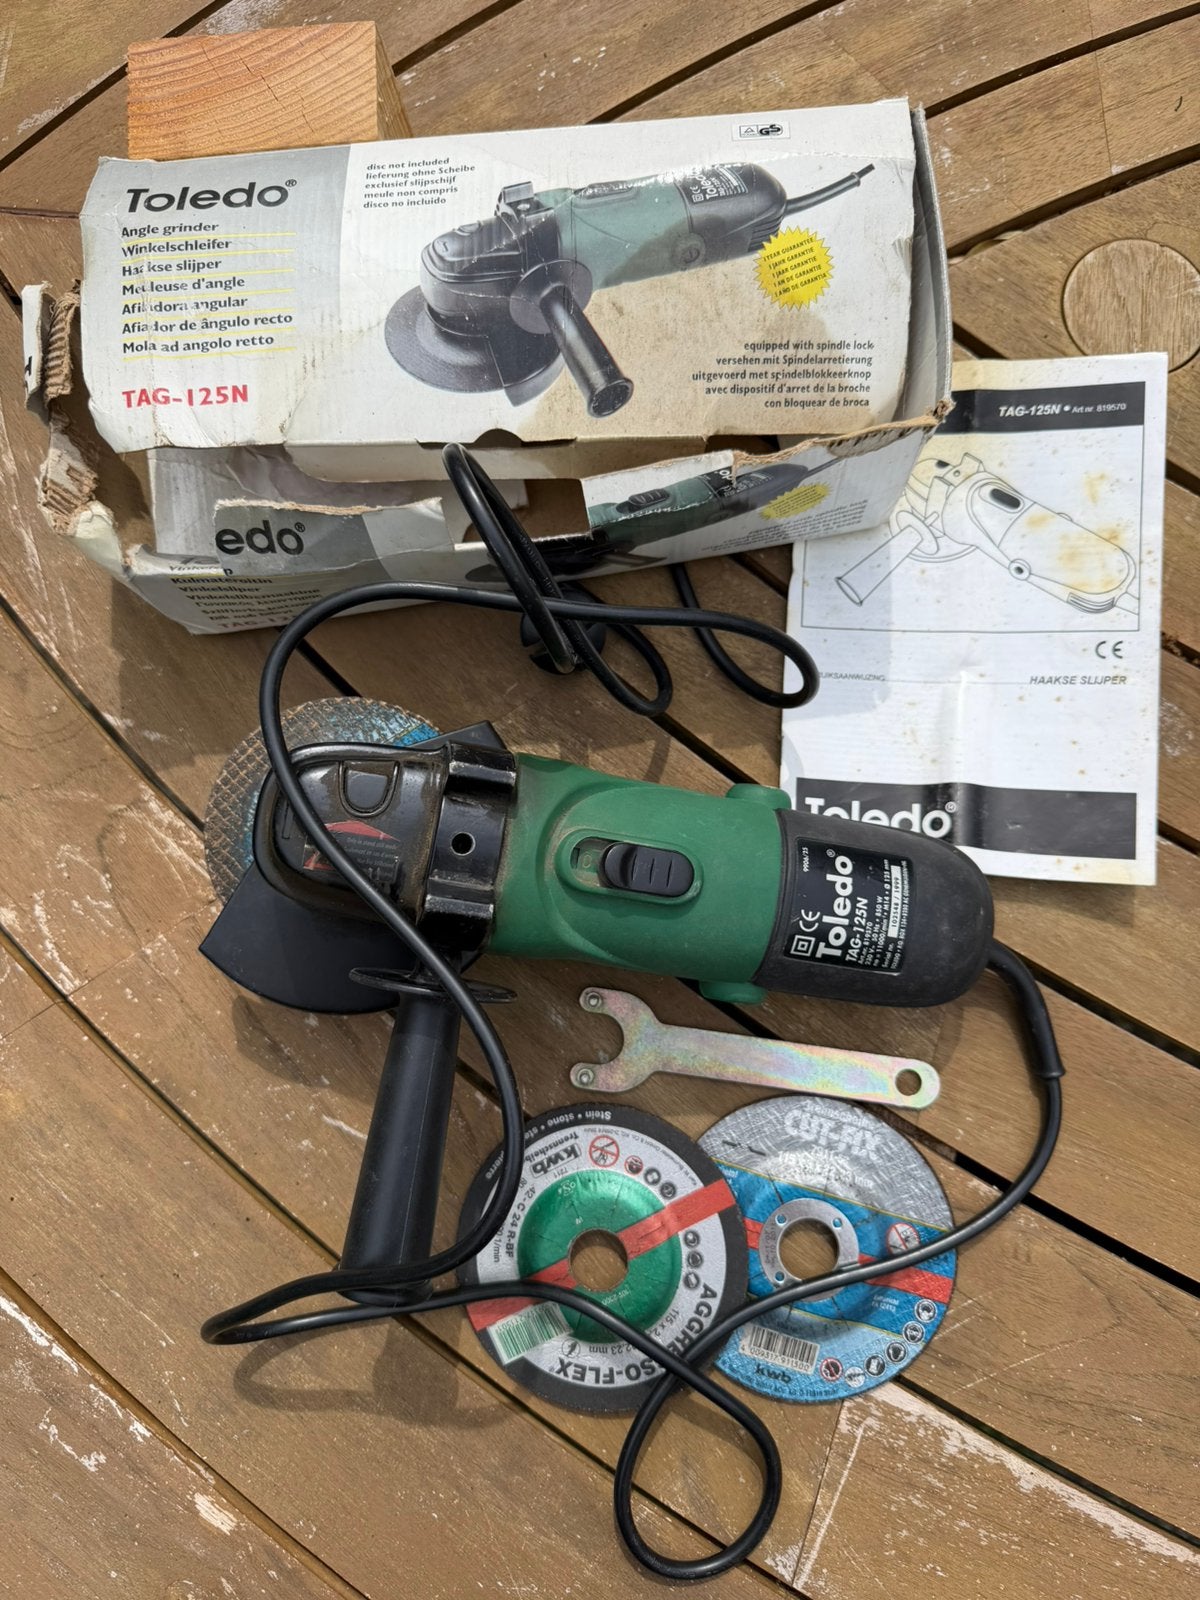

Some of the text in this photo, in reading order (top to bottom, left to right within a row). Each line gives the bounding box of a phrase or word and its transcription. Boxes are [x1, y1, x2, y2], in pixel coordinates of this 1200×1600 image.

[408, 158, 449, 167] included
[366, 171, 409, 179] lieferung
[439, 165, 475, 174] Scheibe
[365, 176, 456, 189] exclusief slijpschijf
[419, 186, 458, 195] compris
[407, 197, 446, 206] incluido
[122, 223, 219, 237] Angle grinder
[122, 240, 232, 257] Winkelschleifer
[782, 237, 813, 253] GUARANTEE
[787, 247, 814, 262] GARANTIE
[177, 260, 222, 273] slijper
[790, 256, 816, 270] GARANTIE
[795, 264, 821, 278] GARANTIE
[192, 277, 245, 291] d'angle
[191, 297, 248, 312] angular
[180, 316, 197, 331] de
[201, 312, 249, 330] ângulo
[254, 314, 293, 323] recto
[123, 335, 274, 353] Mola ad angolo retto
[744, 341, 874, 352] equipped with spindle lock
[716, 355, 872, 366] versehen mit Spindelarretierung
[692, 370, 871, 383] uitgevoerd met spindelblokkeerknop
[122, 385, 248, 408] TAG-125N
[705, 384, 870, 396] avec dispositif d'arret de la broche
[764, 398, 869, 410] con bloquear de broca
[999, 404, 1061, 417] TAG-125N
[1030, 674, 1127, 685] HAAKSE SLIJPER
[816, 856, 853, 958] Toledo
[876, 896, 883, 904] W
[891, 903, 899, 928] 102548
[845, 897, 868, 961] TAG-125N
[882, 951, 891, 968] Serial
[547, 1114, 574, 1127] stone
[585, 1110, 612, 1120] Stein
[785, 1109, 882, 1161] CUT-FIX
[524, 1131, 579, 1162] Trennscheib
[531, 1144, 581, 1177] kwb
[493, 1237, 503, 1263] 1/min
[665, 1307, 679, 1324] 115
[556, 1283, 718, 1384] AGGRESO-FLEX
[589, 1344, 609, 1355] mm
[756, 1364, 791, 1384] kwb
